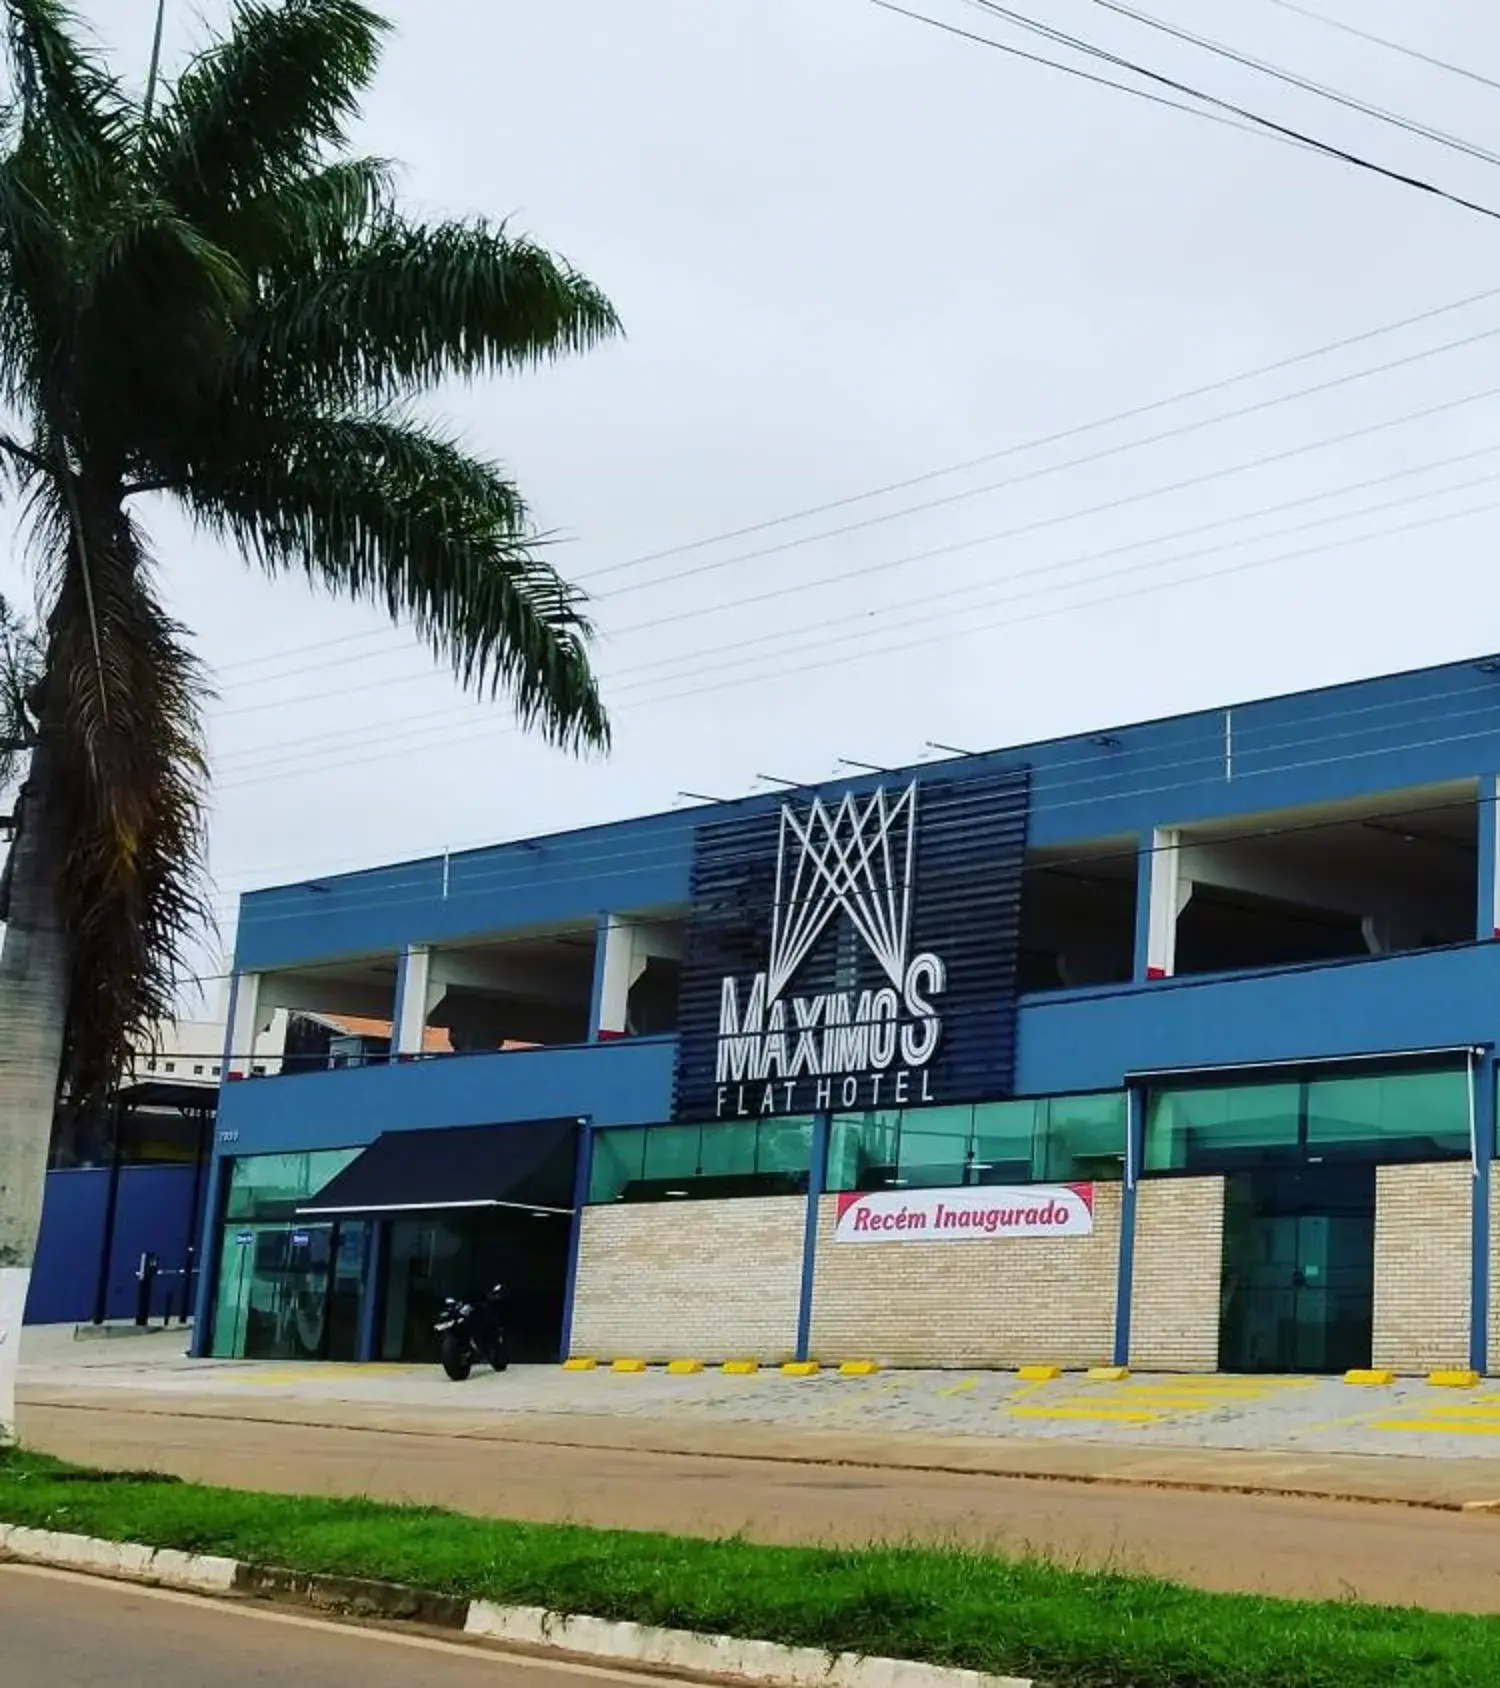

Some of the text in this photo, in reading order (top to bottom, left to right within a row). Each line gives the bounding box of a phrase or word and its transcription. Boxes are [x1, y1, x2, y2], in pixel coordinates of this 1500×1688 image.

[716, 953, 946, 1082] MAXIMOS
[716, 1069, 933, 1117] FLAT HOTEL
[853, 1200, 1070, 1233] Recém Inaugurado
